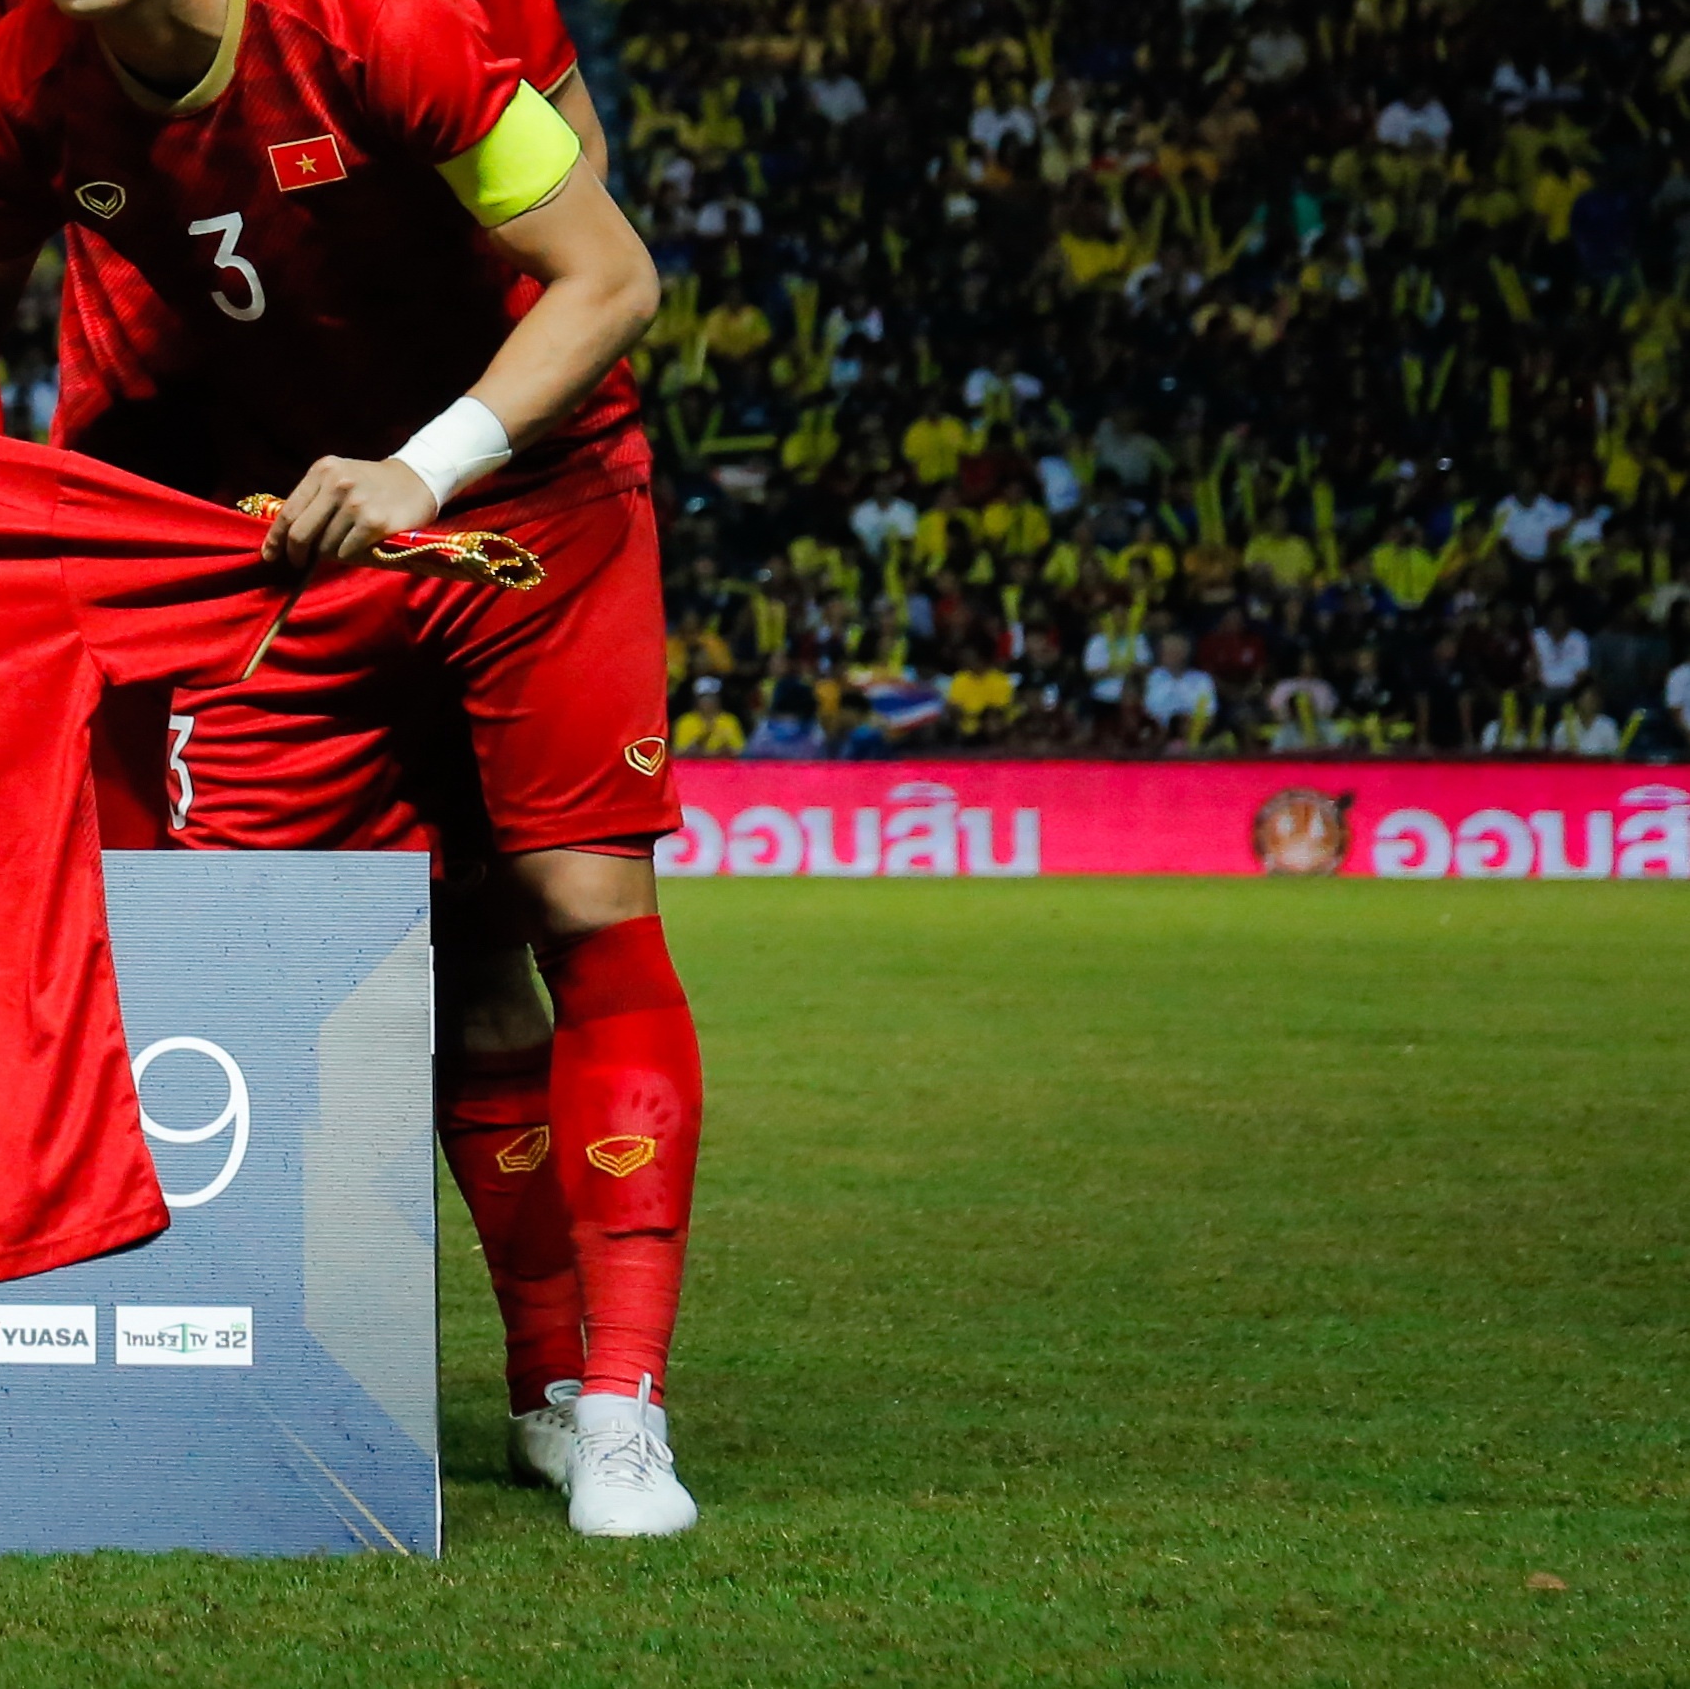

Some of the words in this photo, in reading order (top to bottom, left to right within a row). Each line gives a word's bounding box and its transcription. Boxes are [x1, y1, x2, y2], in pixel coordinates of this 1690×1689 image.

[187, 211, 267, 322] 3
[168, 714, 195, 830] 3
[653, 781, 1040, 877] ออมสิน
[2, 1328, 90, 1348] YUASA
[189, 1332, 209, 1347] TV
[215, 1330, 247, 1349] 32
